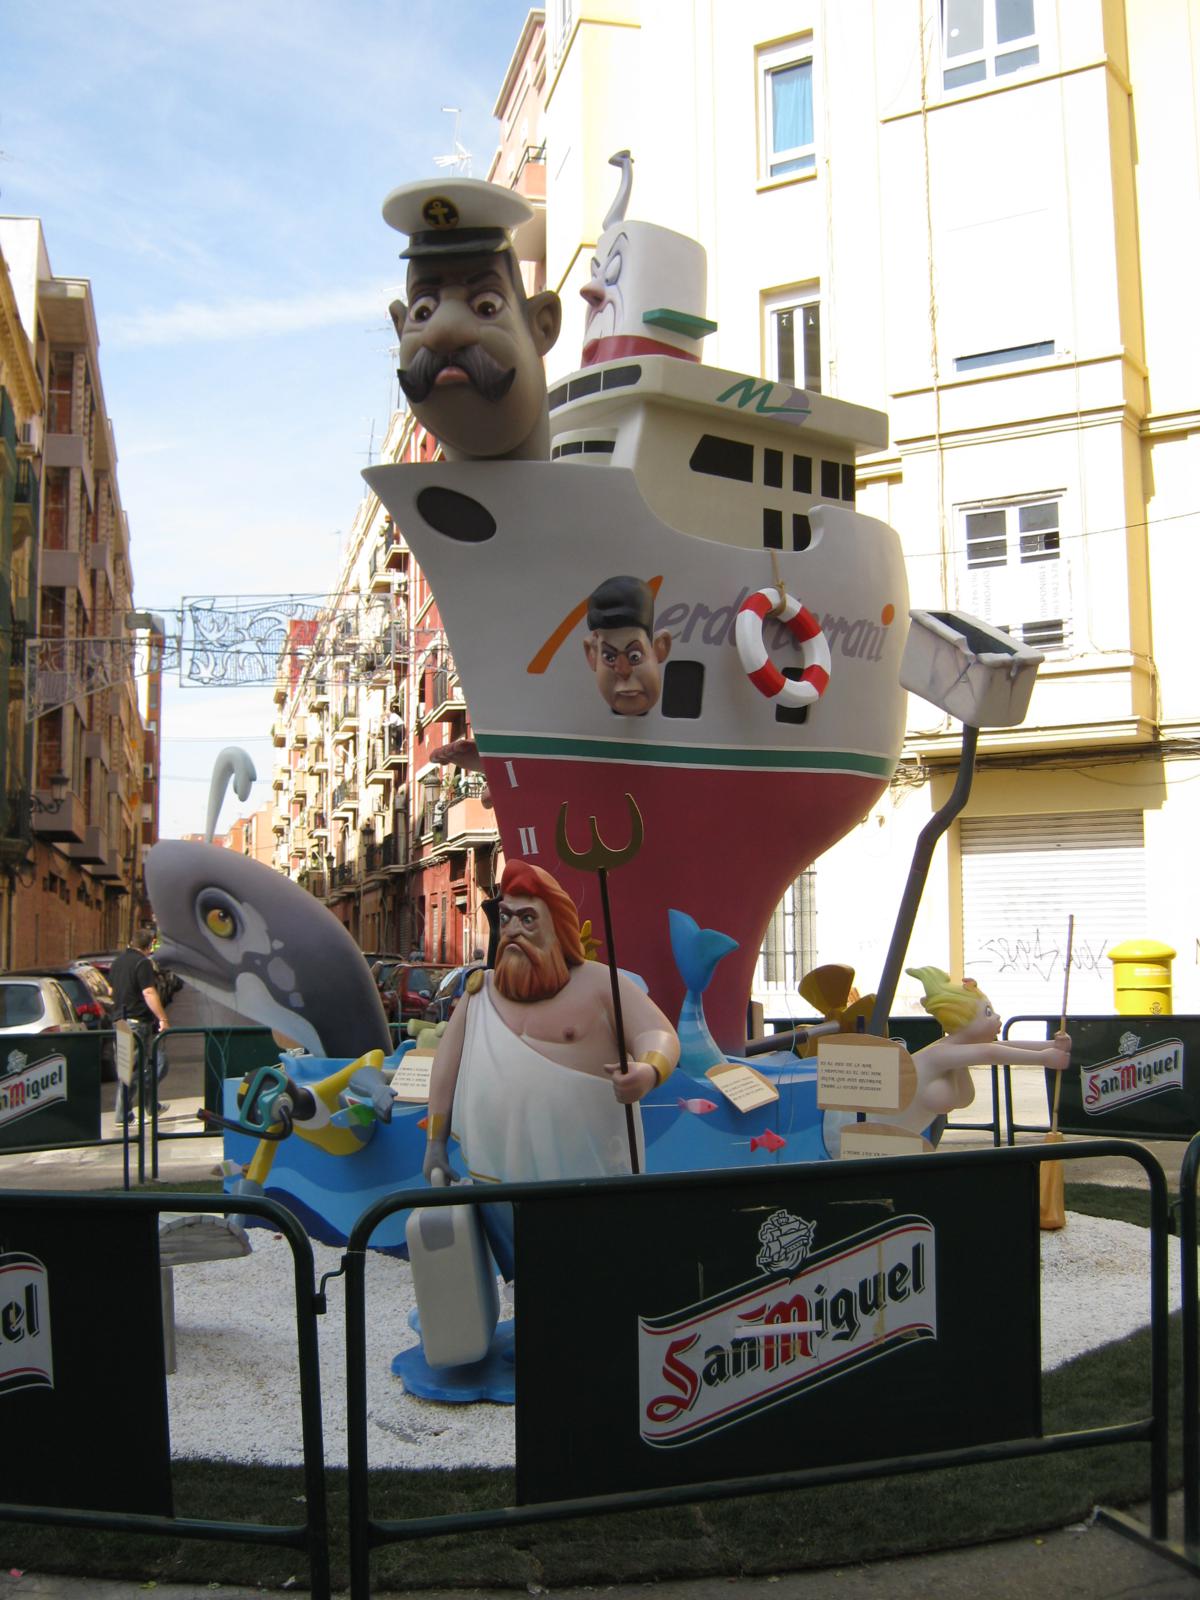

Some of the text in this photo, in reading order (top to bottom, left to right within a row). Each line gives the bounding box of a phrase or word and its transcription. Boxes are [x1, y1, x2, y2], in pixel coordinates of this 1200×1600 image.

[2, 1064, 63, 1109] Miguel
[1085, 1050, 1179, 1104] San Miguel
[1, 1283, 40, 1344] el
[646, 1242, 926, 1423] San Miguel
